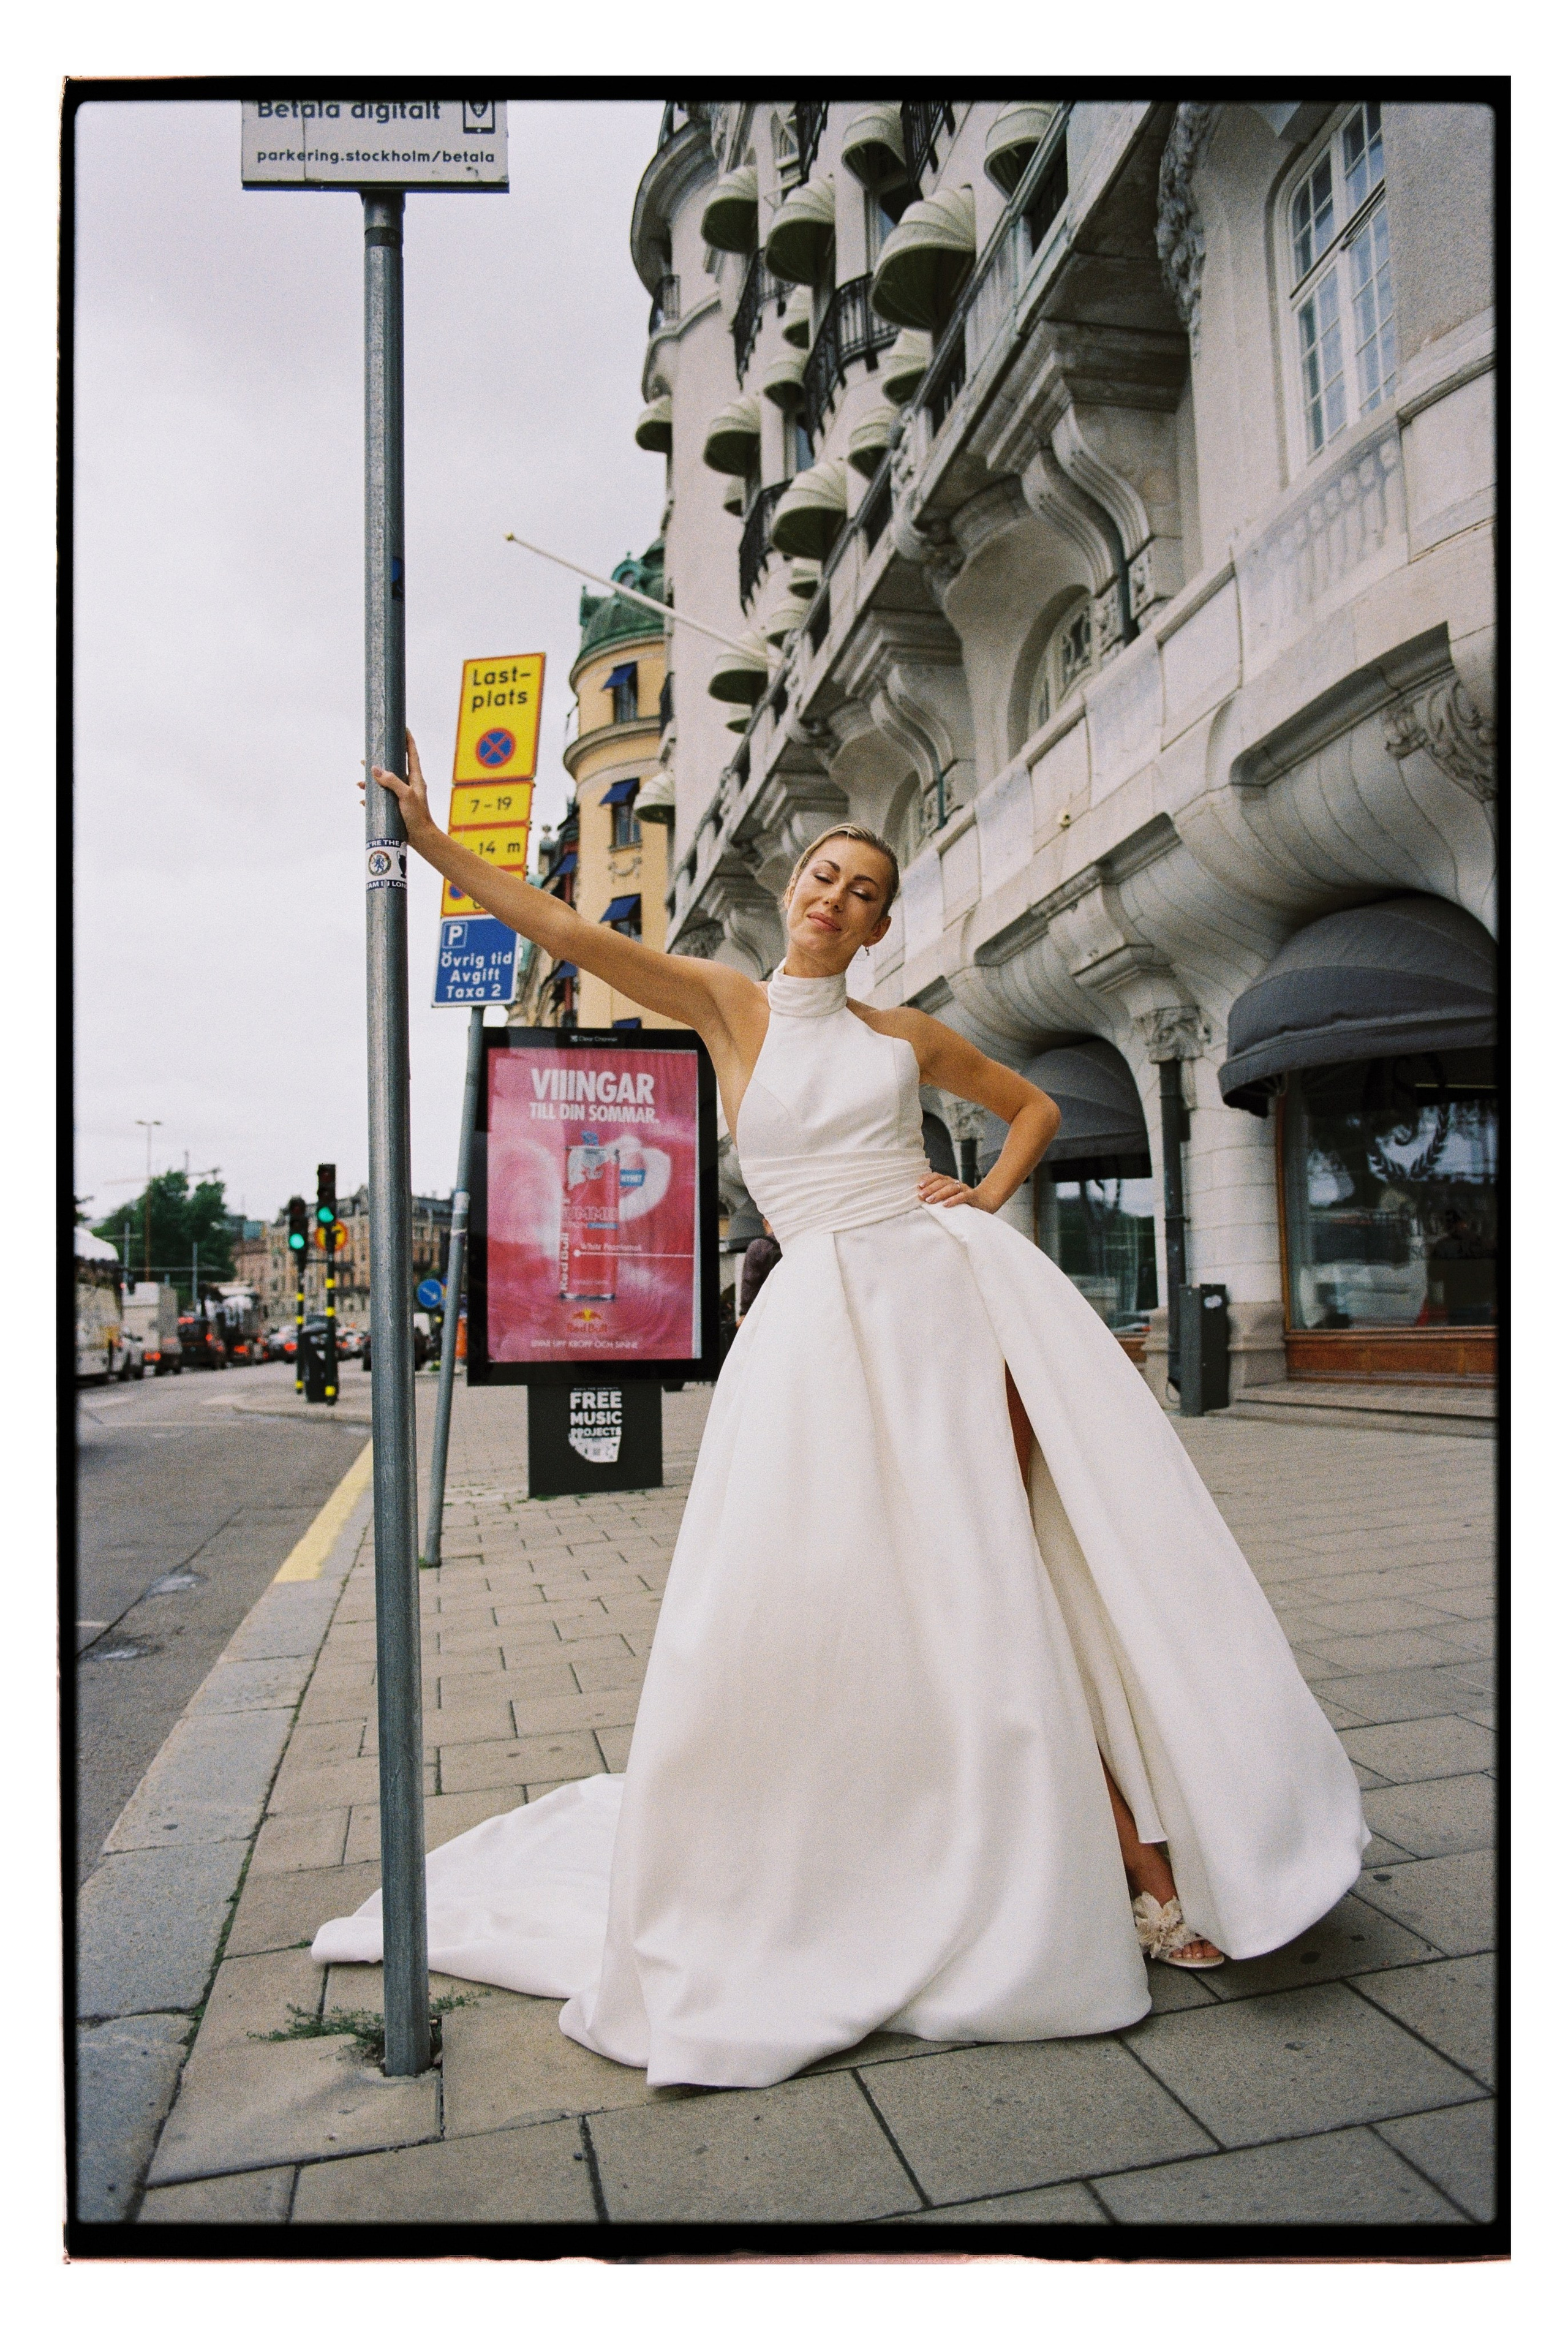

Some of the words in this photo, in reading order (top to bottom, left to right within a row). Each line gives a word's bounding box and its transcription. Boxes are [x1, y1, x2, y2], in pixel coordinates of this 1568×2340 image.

[257, 100, 340, 118] Betala
[351, 100, 440, 123] digitalt
[257, 149, 495, 164] parkering.stockholm/betala
[473, 666, 530, 686] Last-
[472, 690, 527, 712] plats
[507, 842, 521, 852] m
[448, 925, 463, 945] P
[441, 951, 484, 969] Övrig
[491, 951, 513, 965] tid
[450, 968, 500, 984] Avgift
[447, 985, 484, 999] Taxa
[491, 983, 501, 997] 2
[530, 1068, 655, 1104] VIIINGAR
[530, 1103, 556, 1120] TILL
[559, 1103, 585, 1120] DIN
[589, 1104, 660, 1123] SOMMAR.
[567, 1323, 586, 1332] Red
[588, 1323, 608, 1332] Bull
[570, 1391, 622, 1409] FREE
[570, 1411, 622, 1425] MUSIC
